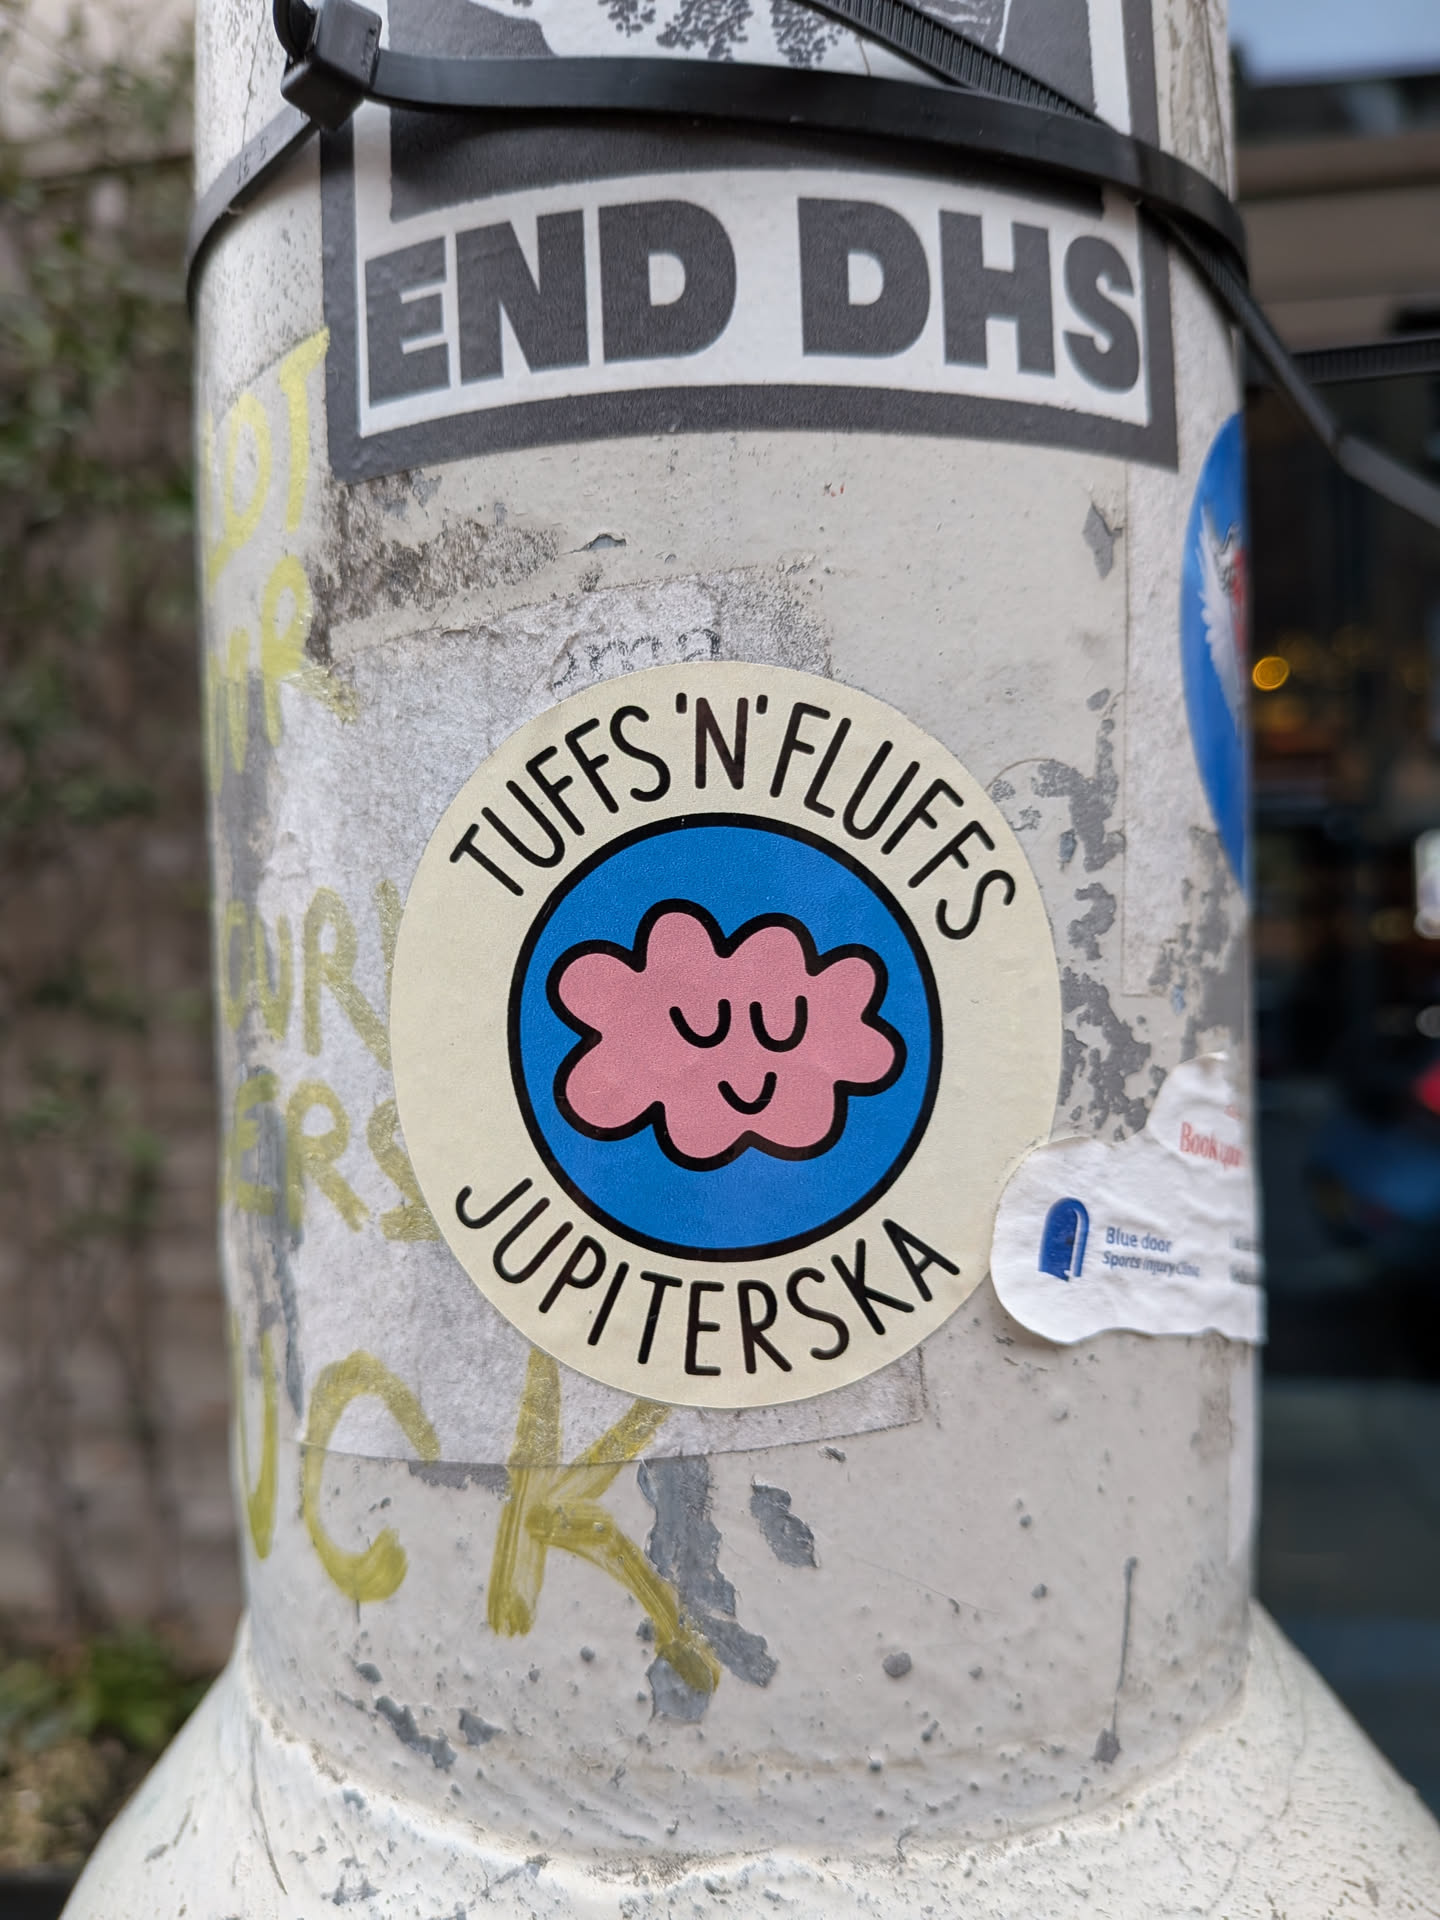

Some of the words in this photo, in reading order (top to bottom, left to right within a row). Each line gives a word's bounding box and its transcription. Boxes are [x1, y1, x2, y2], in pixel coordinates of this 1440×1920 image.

[364, 198, 737, 408] END
[797, 197, 1141, 393] DHS
[450, 704, 671, 896] TUFFS
[770, 701, 1016, 940] FLUFFS
[455, 1178, 960, 1377] JUPITERSKA
[1102, 1250, 1141, 1270] Sports
[1105, 1226, 1138, 1248] Blue
[1141, 1232, 1172, 1253] door
